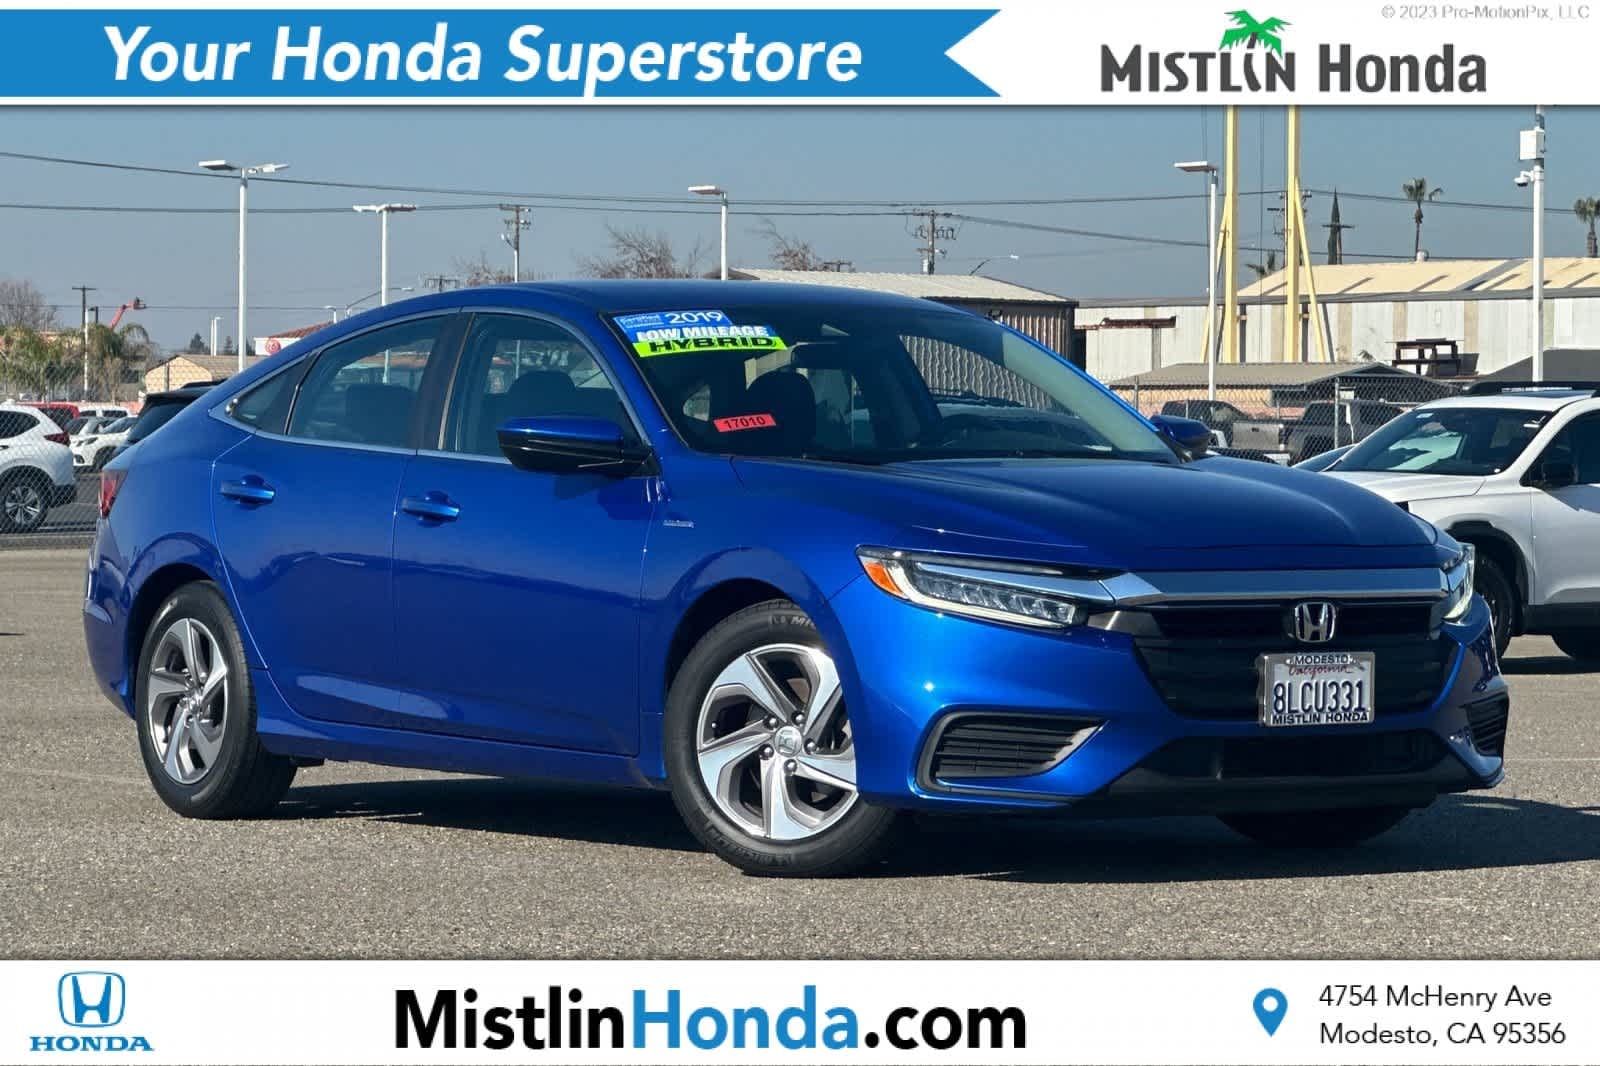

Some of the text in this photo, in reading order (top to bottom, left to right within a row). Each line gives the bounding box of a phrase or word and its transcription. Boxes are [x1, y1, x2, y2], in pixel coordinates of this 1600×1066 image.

[665, 312, 722, 324] 2019
[636, 325, 769, 342] LOW MILEAGE
[651, 337, 773, 351] HYBRID
[723, 415, 766, 430] 17010
[1294, 655, 1349, 665] MODESTO
[1273, 681, 1366, 713] 8LCU331
[1272, 713, 1368, 725] MISTLIN HONDA
